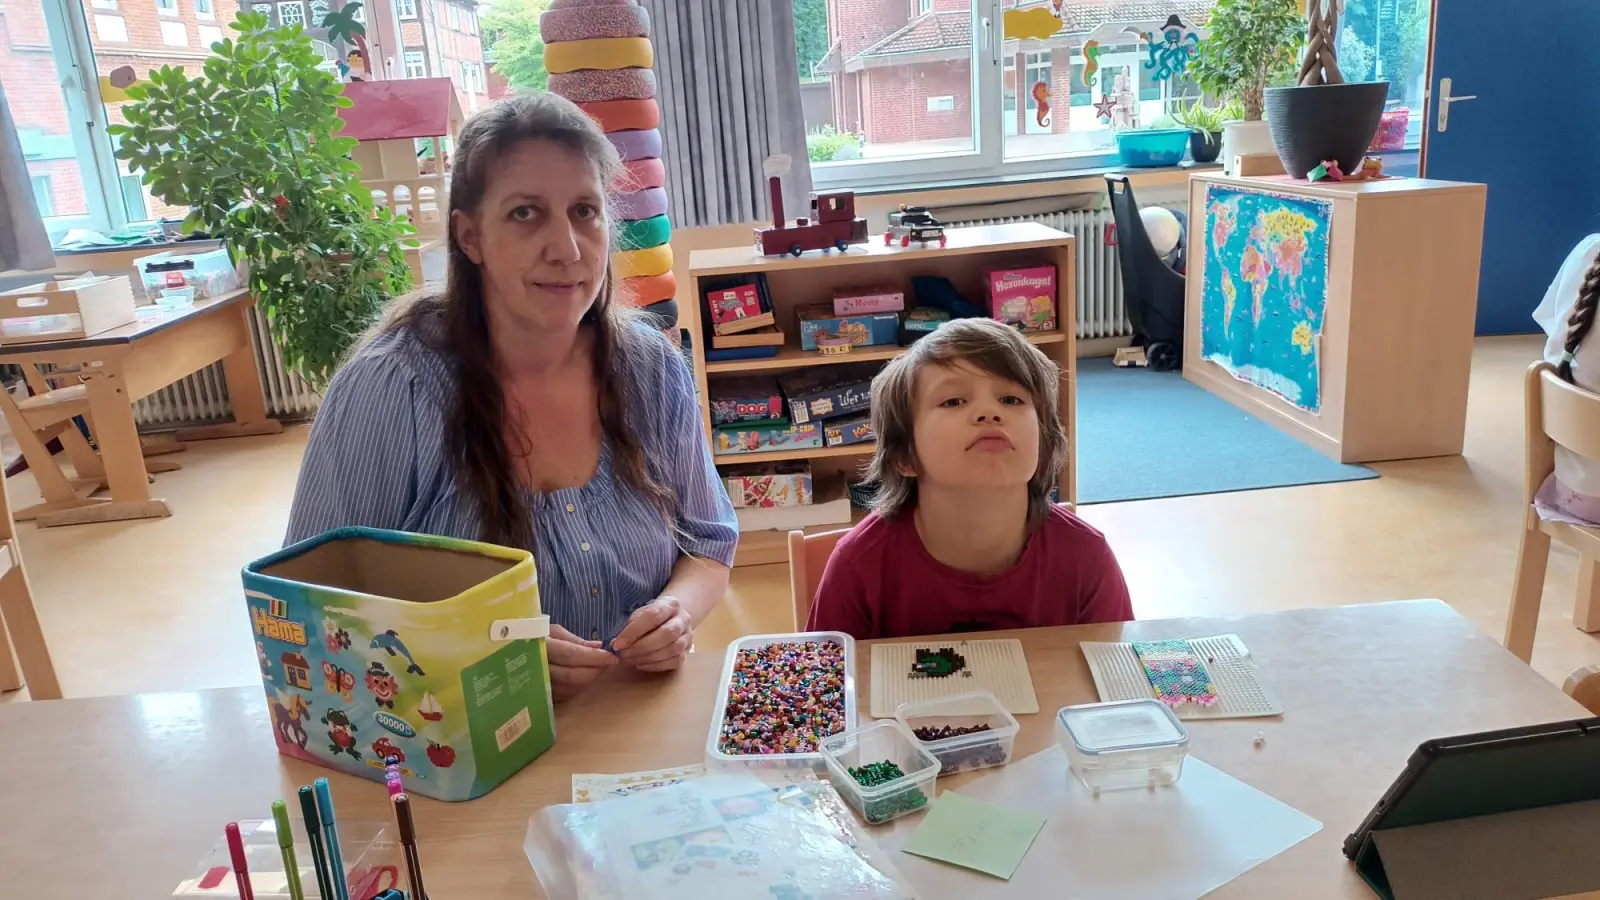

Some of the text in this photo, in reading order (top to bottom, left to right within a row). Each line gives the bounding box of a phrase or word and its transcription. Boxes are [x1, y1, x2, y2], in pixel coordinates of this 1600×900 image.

[736, 403, 768, 415] DOG
[251, 606, 308, 646] Hama
[378, 714, 405, 732] 30000
